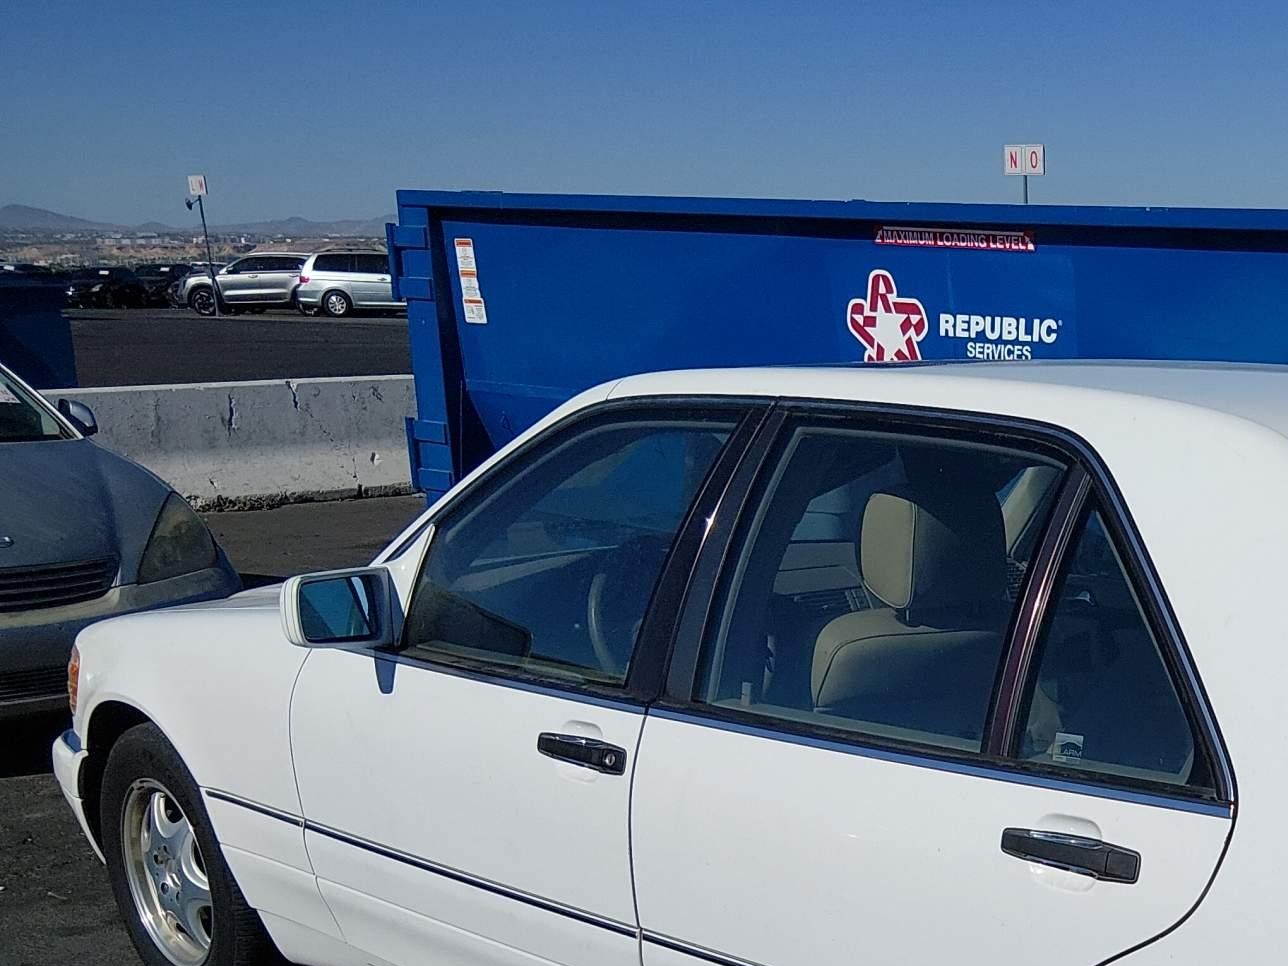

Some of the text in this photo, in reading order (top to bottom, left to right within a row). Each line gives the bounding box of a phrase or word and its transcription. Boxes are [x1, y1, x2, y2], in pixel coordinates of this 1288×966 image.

[1009, 151, 1018, 169] N
[883, 230, 1027, 250] MAXIMUM LOADING LEVEL
[939, 313, 1058, 344] REPUBLIC
[966, 341, 1032, 361] SERVICES
